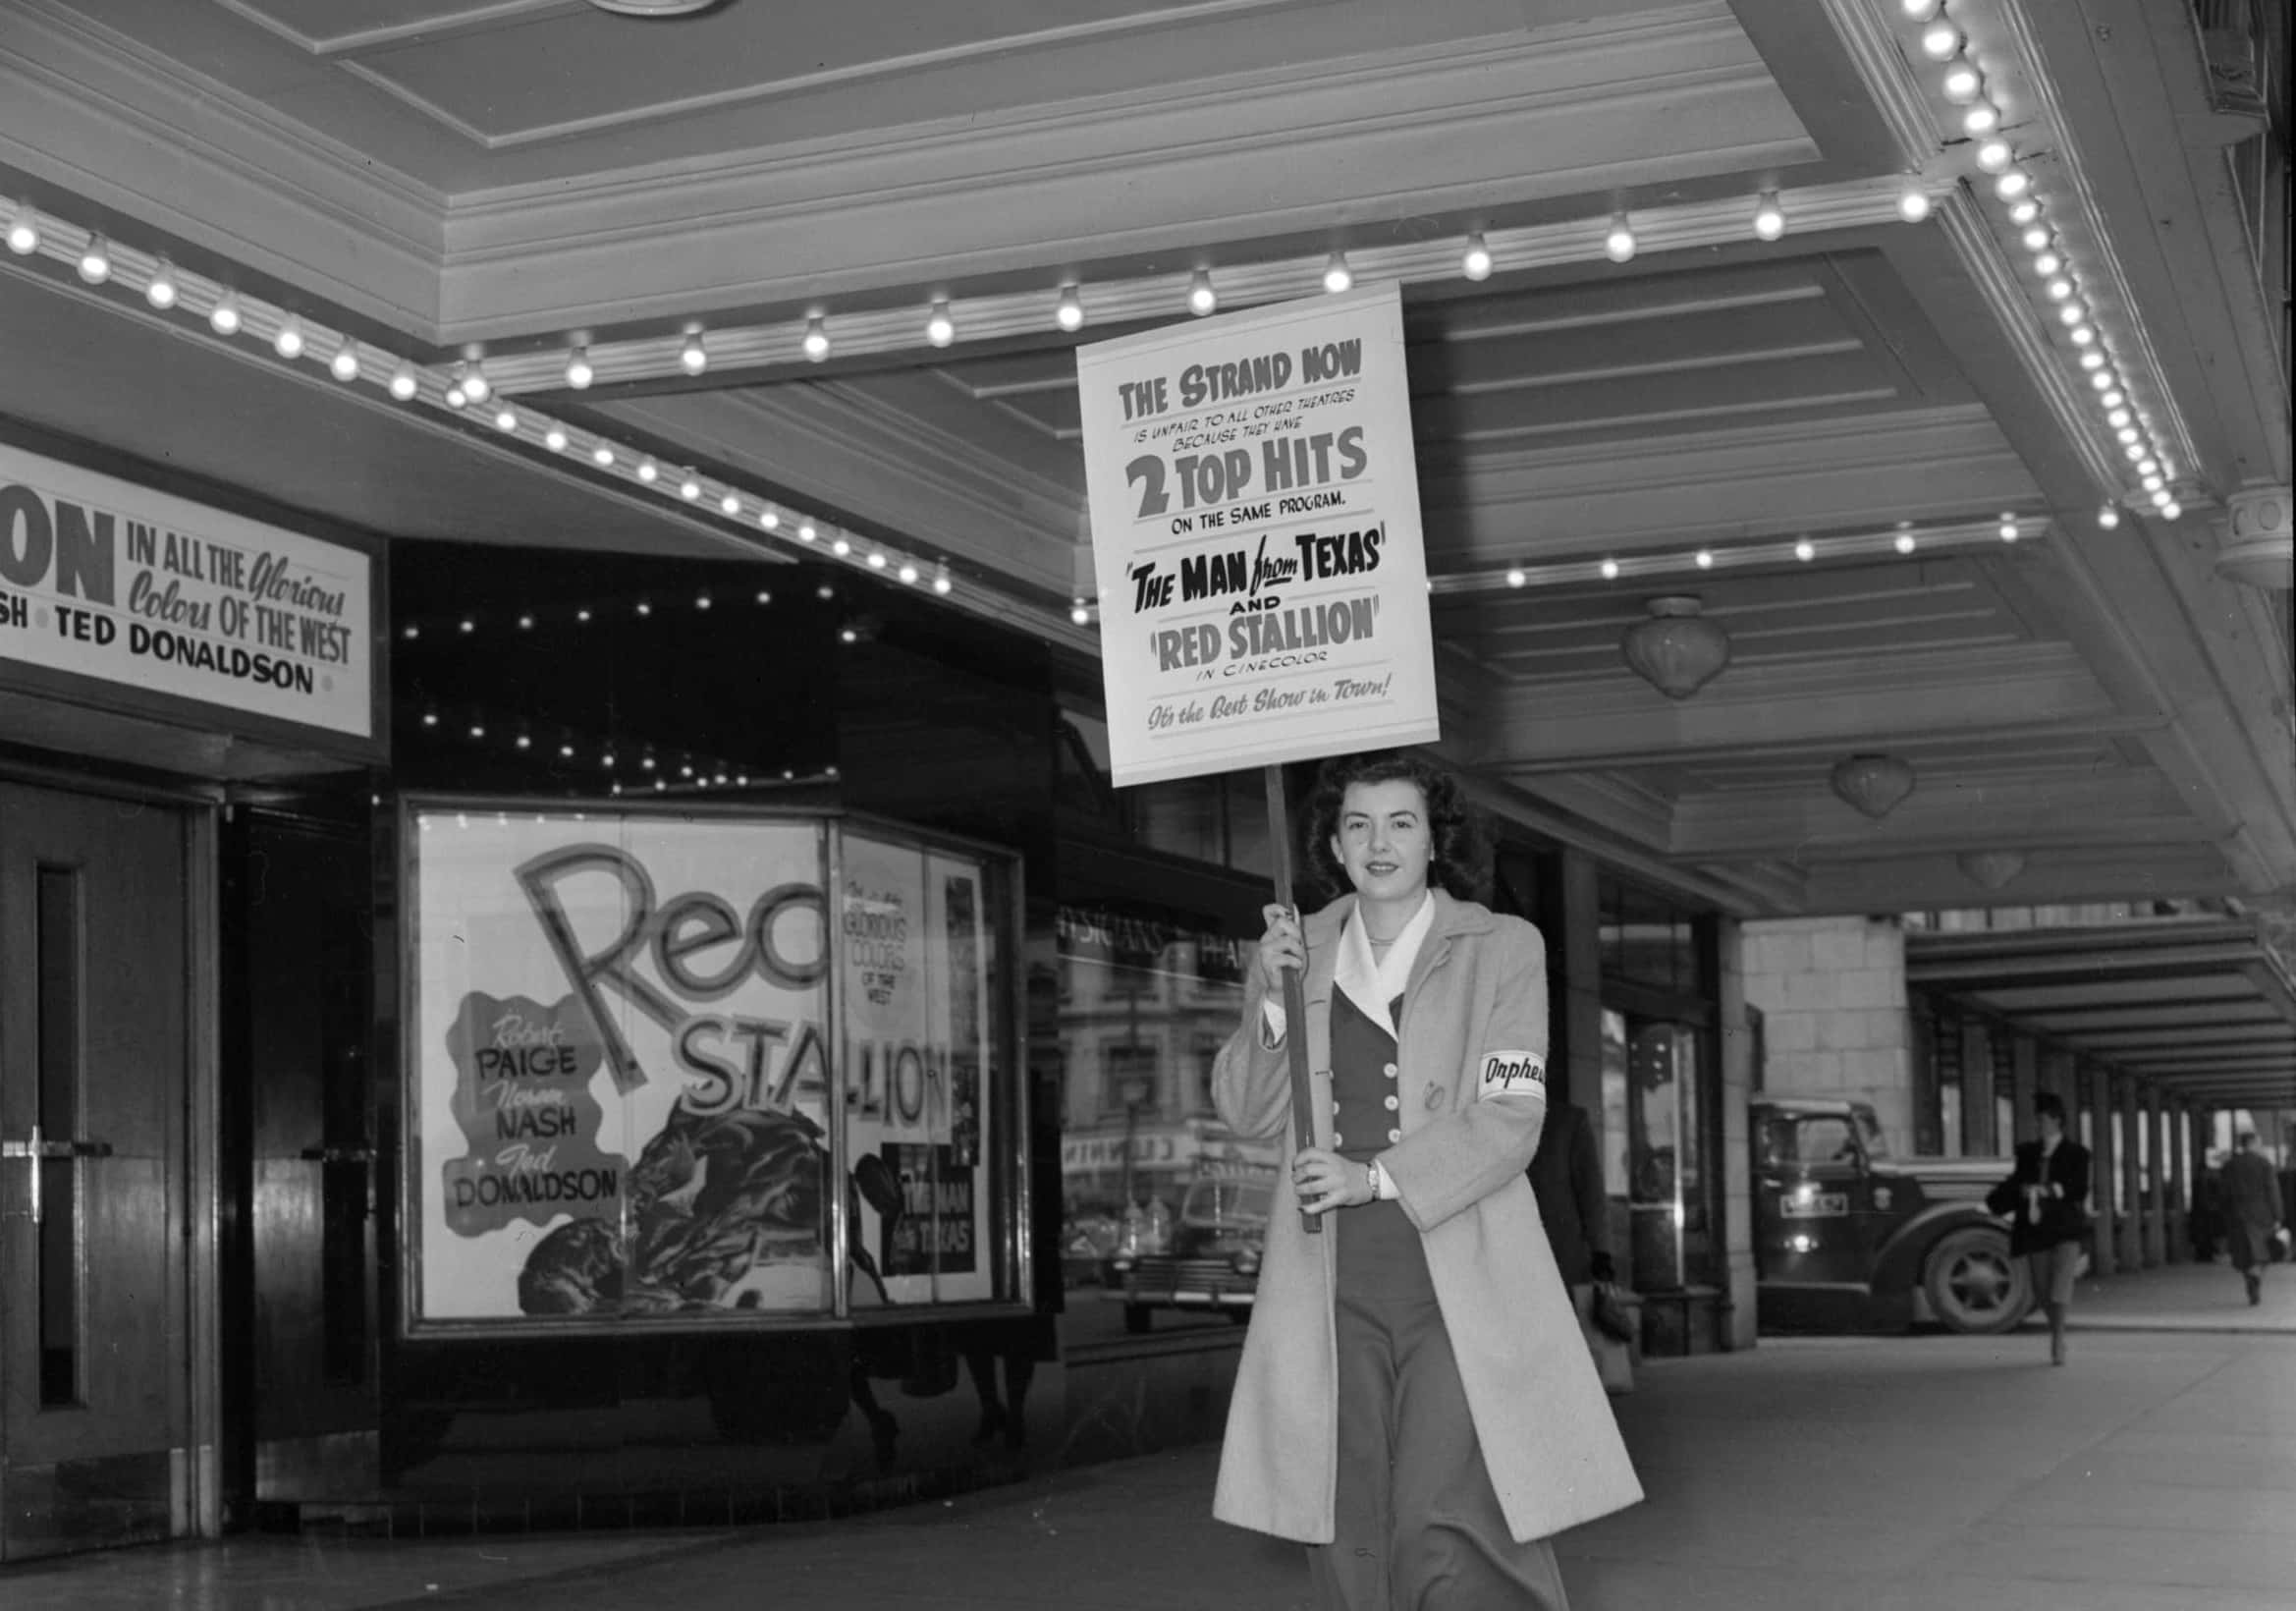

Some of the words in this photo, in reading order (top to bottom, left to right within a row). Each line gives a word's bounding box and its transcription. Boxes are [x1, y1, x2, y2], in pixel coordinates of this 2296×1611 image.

[1119, 377, 1168, 420] THE
[1179, 352, 1291, 408] STRAND
[1301, 338, 1362, 384] NOW
[1134, 429, 1147, 442] IS
[1152, 419, 1199, 440] UNFAIR
[1204, 414, 1224, 427] TO
[1228, 409, 1248, 423] ALL
[1254, 400, 1292, 419] OTHER
[1297, 389, 1355, 410] THEATRES
[1173, 428, 1237, 453] BECAUSE
[1242, 422, 1271, 438] THEY
[1274, 416, 1303, 432] HAVE
[1124, 454, 1171, 519] 2
[1175, 448, 1252, 509] TOP
[1262, 425, 1368, 493] HITS
[1171, 517, 1193, 535] ON
[1199, 510, 1226, 529] THE
[1230, 504, 1272, 525] SAME
[1279, 490, 1346, 517] PROGRAM.
[0, 484, 115, 607] ON
[127, 520, 157, 567] IN
[162, 531, 204, 581] ALL
[206, 543, 245, 591] THE
[247, 550, 346, 617] Glorious
[1180, 550, 1247, 602] MAN
[1249, 533, 1297, 597] from
[129, 569, 212, 631] Colors
[219, 595, 248, 639] OF
[255, 604, 295, 651] THE
[299, 614, 351, 664] WEST
[1230, 595, 1281, 616] AND
[54, 605, 116, 645] TED
[130, 623, 313, 694] DONALDSON
[1196, 669, 1215, 682] IN
[1223, 651, 1328, 677] CINECOLOR
[1147, 704, 1175, 731] It's
[1177, 699, 1204, 724] the
[1209, 694, 1248, 720] Best
[1253, 688, 1306, 712] Show
[1308, 687, 1329, 702] in
[1334, 673, 1393, 699] Town!
[474, 1046, 577, 1080] PAIGE
[496, 1106, 576, 1140] NASH
[453, 1168, 618, 1209] DONALDSON
[495, 1142, 558, 1182] Ted
